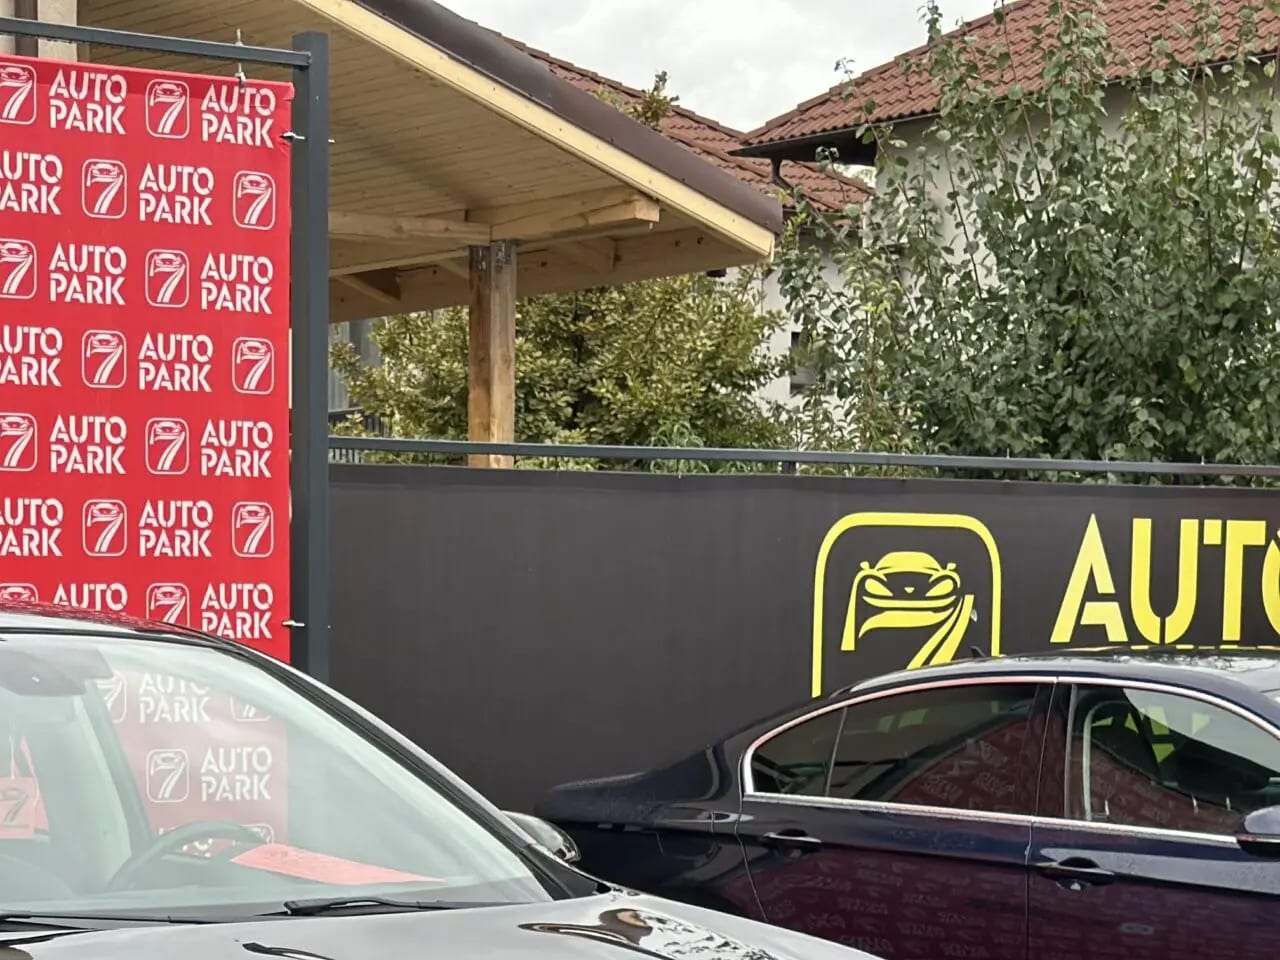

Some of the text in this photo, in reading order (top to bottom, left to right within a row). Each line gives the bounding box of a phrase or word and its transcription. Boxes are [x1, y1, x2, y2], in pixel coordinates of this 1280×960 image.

[49, 70, 127, 105] AUTO
[201, 85, 275, 118] AUTO
[50, 99, 125, 134] PARK
[202, 113, 273, 148] PARK
[139, 163, 213, 198] AUTO
[140, 193, 212, 225] PARK
[49, 243, 126, 274] AUTO
[201, 253, 273, 284] AUTO
[50, 273, 125, 305] PARK
[202, 282, 271, 314] PARK
[139, 333, 213, 362] AUTO
[140, 362, 211, 392] PARK
[50, 415, 126, 444] AUTO
[201, 420, 272, 448] AUTO
[51, 444, 125, 474] PARK
[202, 448, 271, 477] PARK
[139, 500, 213, 528] AUTO
[140, 529, 211, 557] PARK
[54, 583, 127, 611] AUTO
[201, 583, 273, 610] AUTO
[202, 612, 271, 639] PARK
[139, 697, 212, 724] PARK
[201, 745, 272, 773] AUTO
[201, 774, 272, 801] PARK
